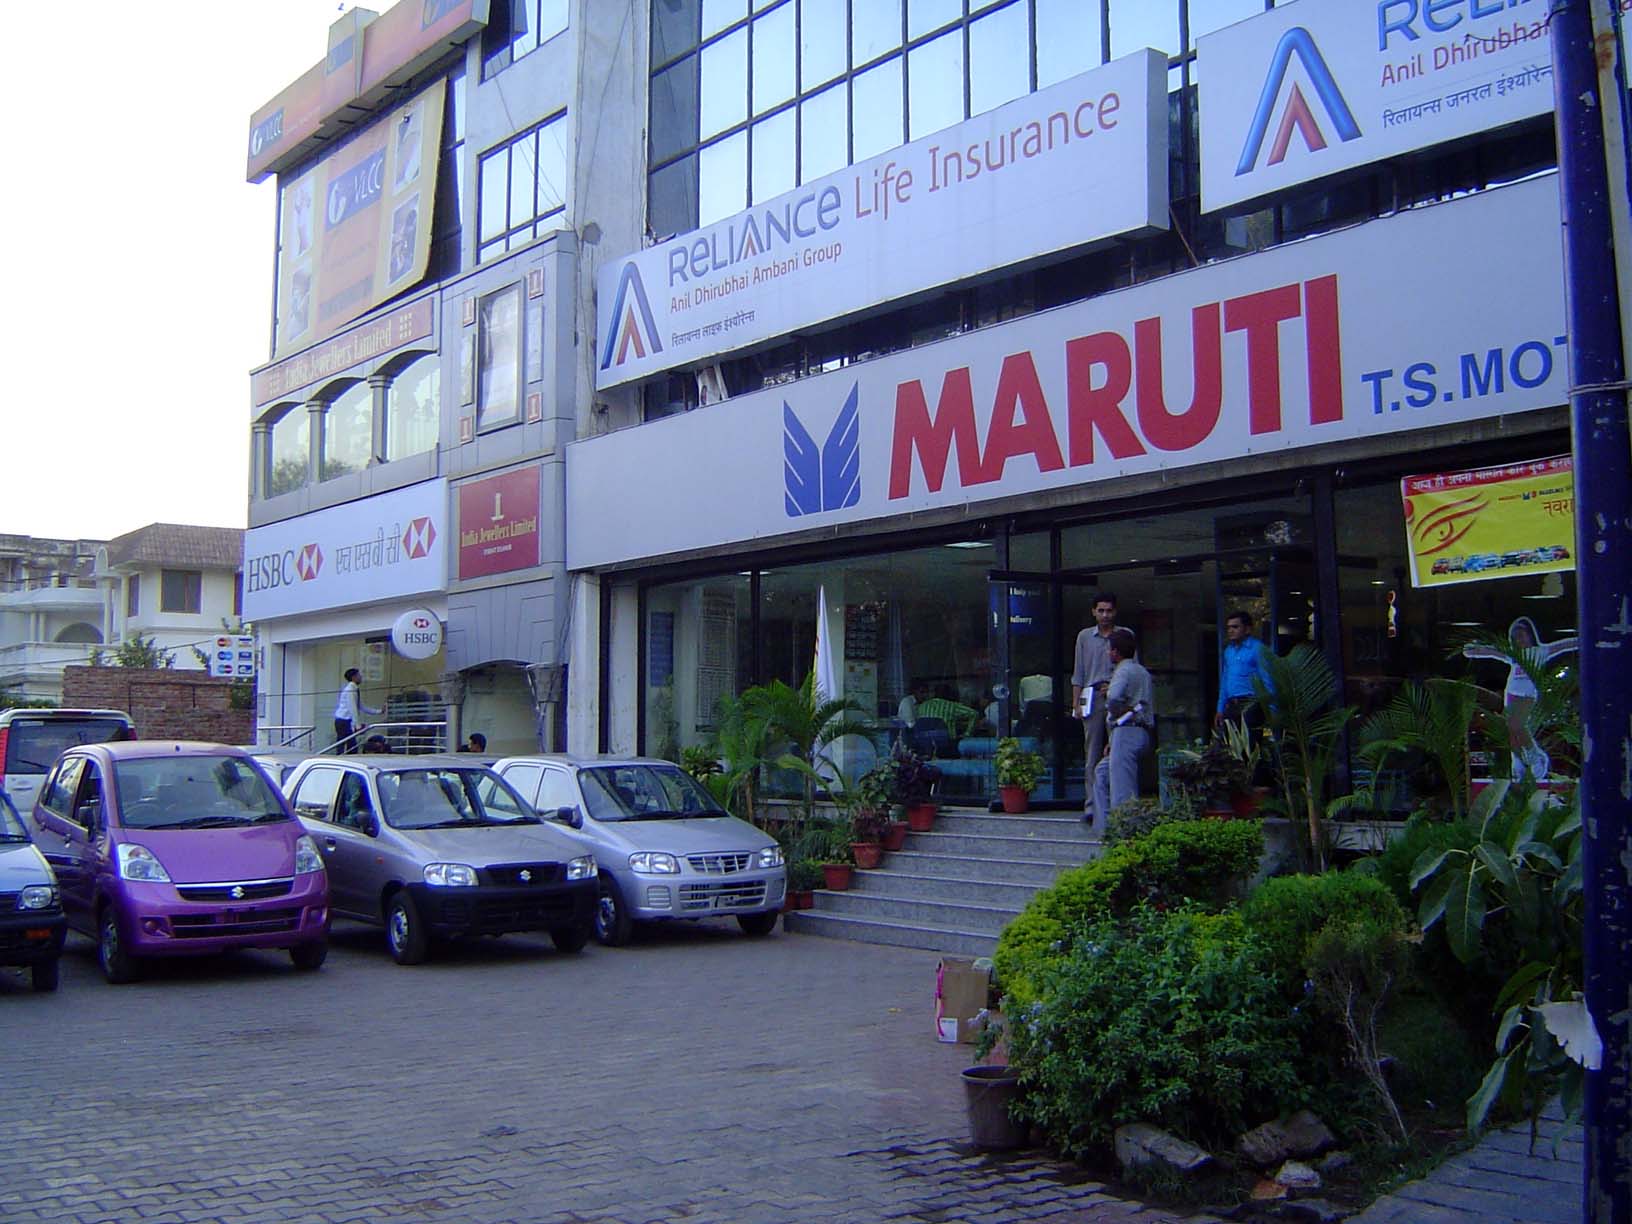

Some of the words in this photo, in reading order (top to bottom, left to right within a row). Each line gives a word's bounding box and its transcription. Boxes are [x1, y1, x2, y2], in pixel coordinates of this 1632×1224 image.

[1381, 53, 1424, 88] Anil
[1433, 13, 1551, 71] Dhirubhai
[1383, 98, 1442, 129] रिलायन्स
[1446, 83, 1492, 109] जनरल
[1495, 64, 1553, 97] इंश्योरेन्
[354, 158, 383, 204] VLCC
[855, 162, 913, 220] Life
[928, 92, 1120, 193] Insurance
[670, 293, 691, 314] Anil
[694, 273, 749, 308] Dhirubhai
[753, 259, 799, 285] Ambani
[803, 243, 842, 267] Group
[353, 320, 392, 360] Limited
[888, 273, 1344, 502] MARUTI
[461, 530, 478, 548] India
[479, 525, 510, 544] Jewellers
[510, 516, 536, 537] Limited
[247, 549, 295, 593] HSBC
[404, 632, 438, 645] HSBC
